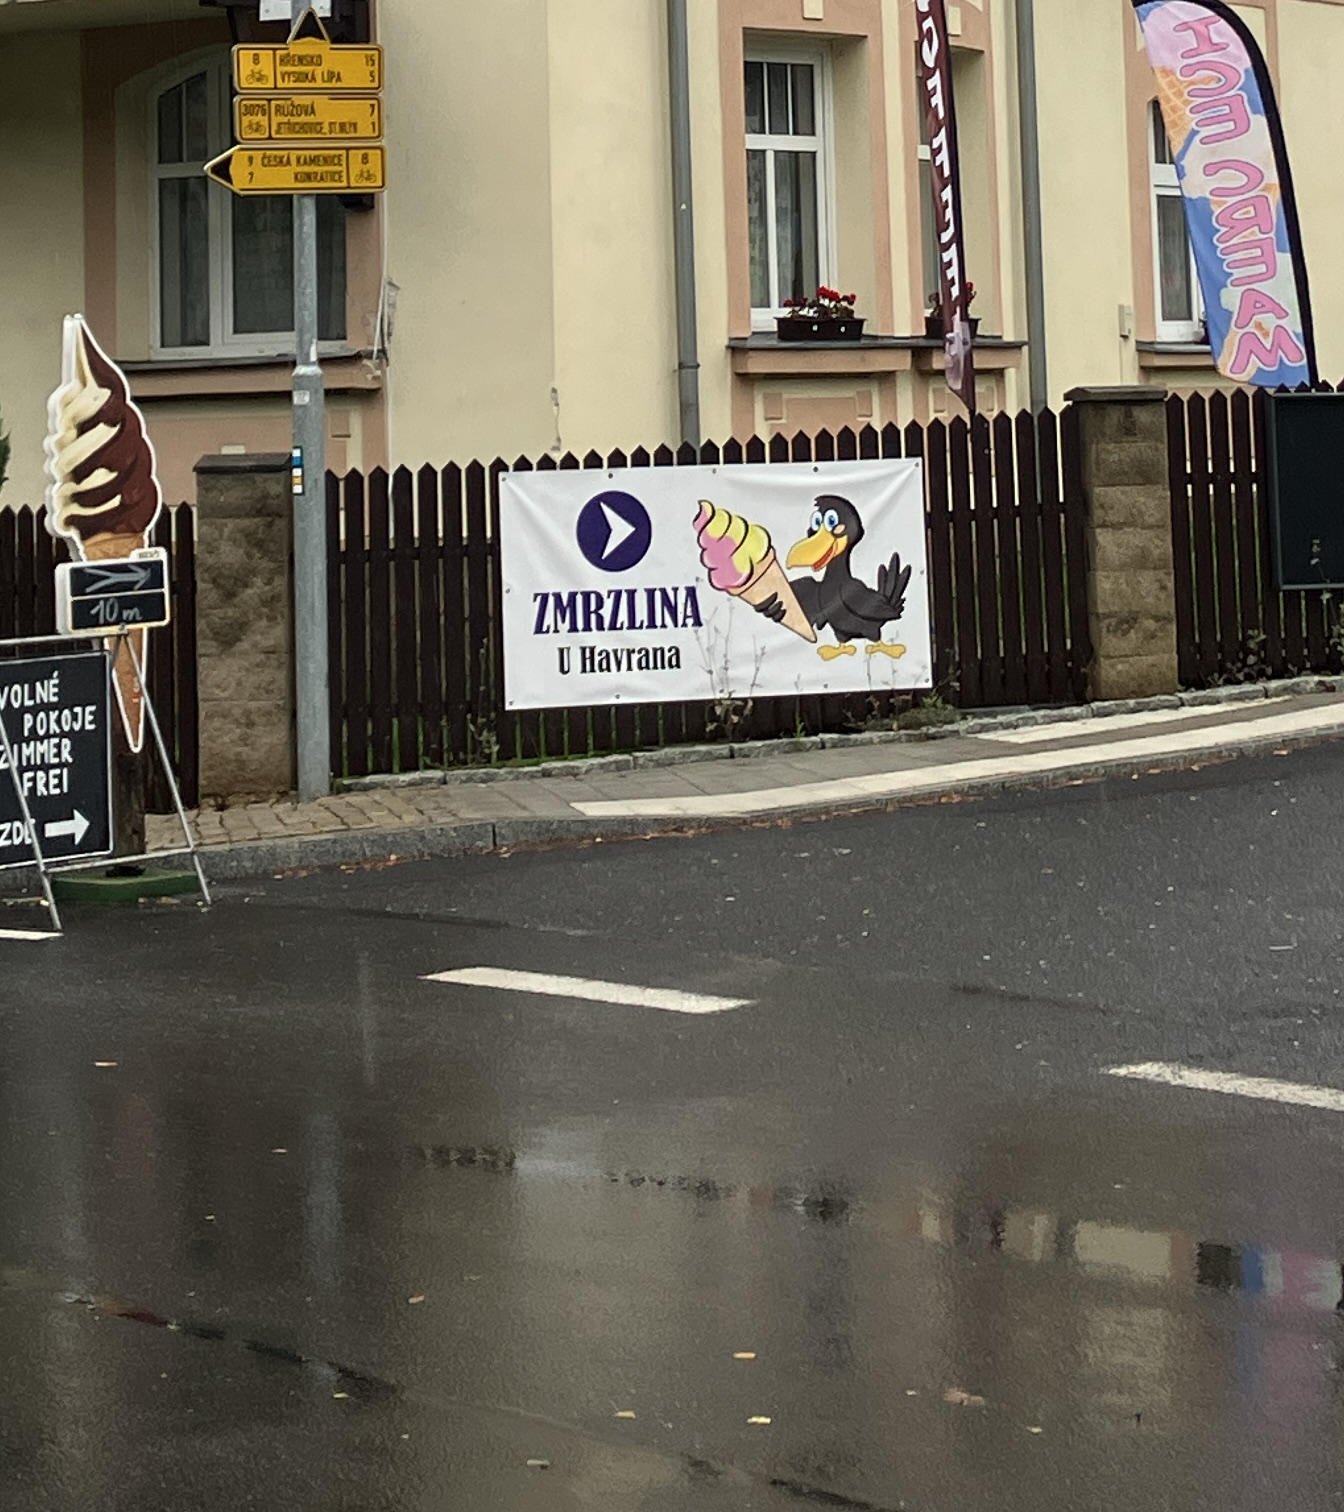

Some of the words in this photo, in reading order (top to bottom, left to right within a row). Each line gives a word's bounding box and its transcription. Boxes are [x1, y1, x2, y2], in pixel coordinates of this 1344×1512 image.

[252, 52, 260, 66] 8
[364, 54, 375, 67] 15
[279, 68, 316, 83] VYSOKÁ
[321, 68, 343, 83] LÍPA
[369, 71, 376, 83] 5
[241, 103, 267, 117] 3076
[274, 99, 316, 117] RŮŽOVÁ
[369, 103, 376, 117] 7
[370, 121, 376, 134] 1
[247, 154, 254, 167] 9
[261, 152, 293, 167] ČESKÁ
[296, 153, 343, 167] KAMENICE
[361, 152, 369, 165] 8
[248, 171, 254, 184] 7
[90, 597, 119, 625] 10
[122, 606, 143, 621] m
[532, 585, 703, 635] ZMRZLINA
[557, 646, 570, 676] U
[579, 643, 682, 674] Havrana
[23, 705, 97, 737] POKOJE
[22, 767, 69, 797] FREI
